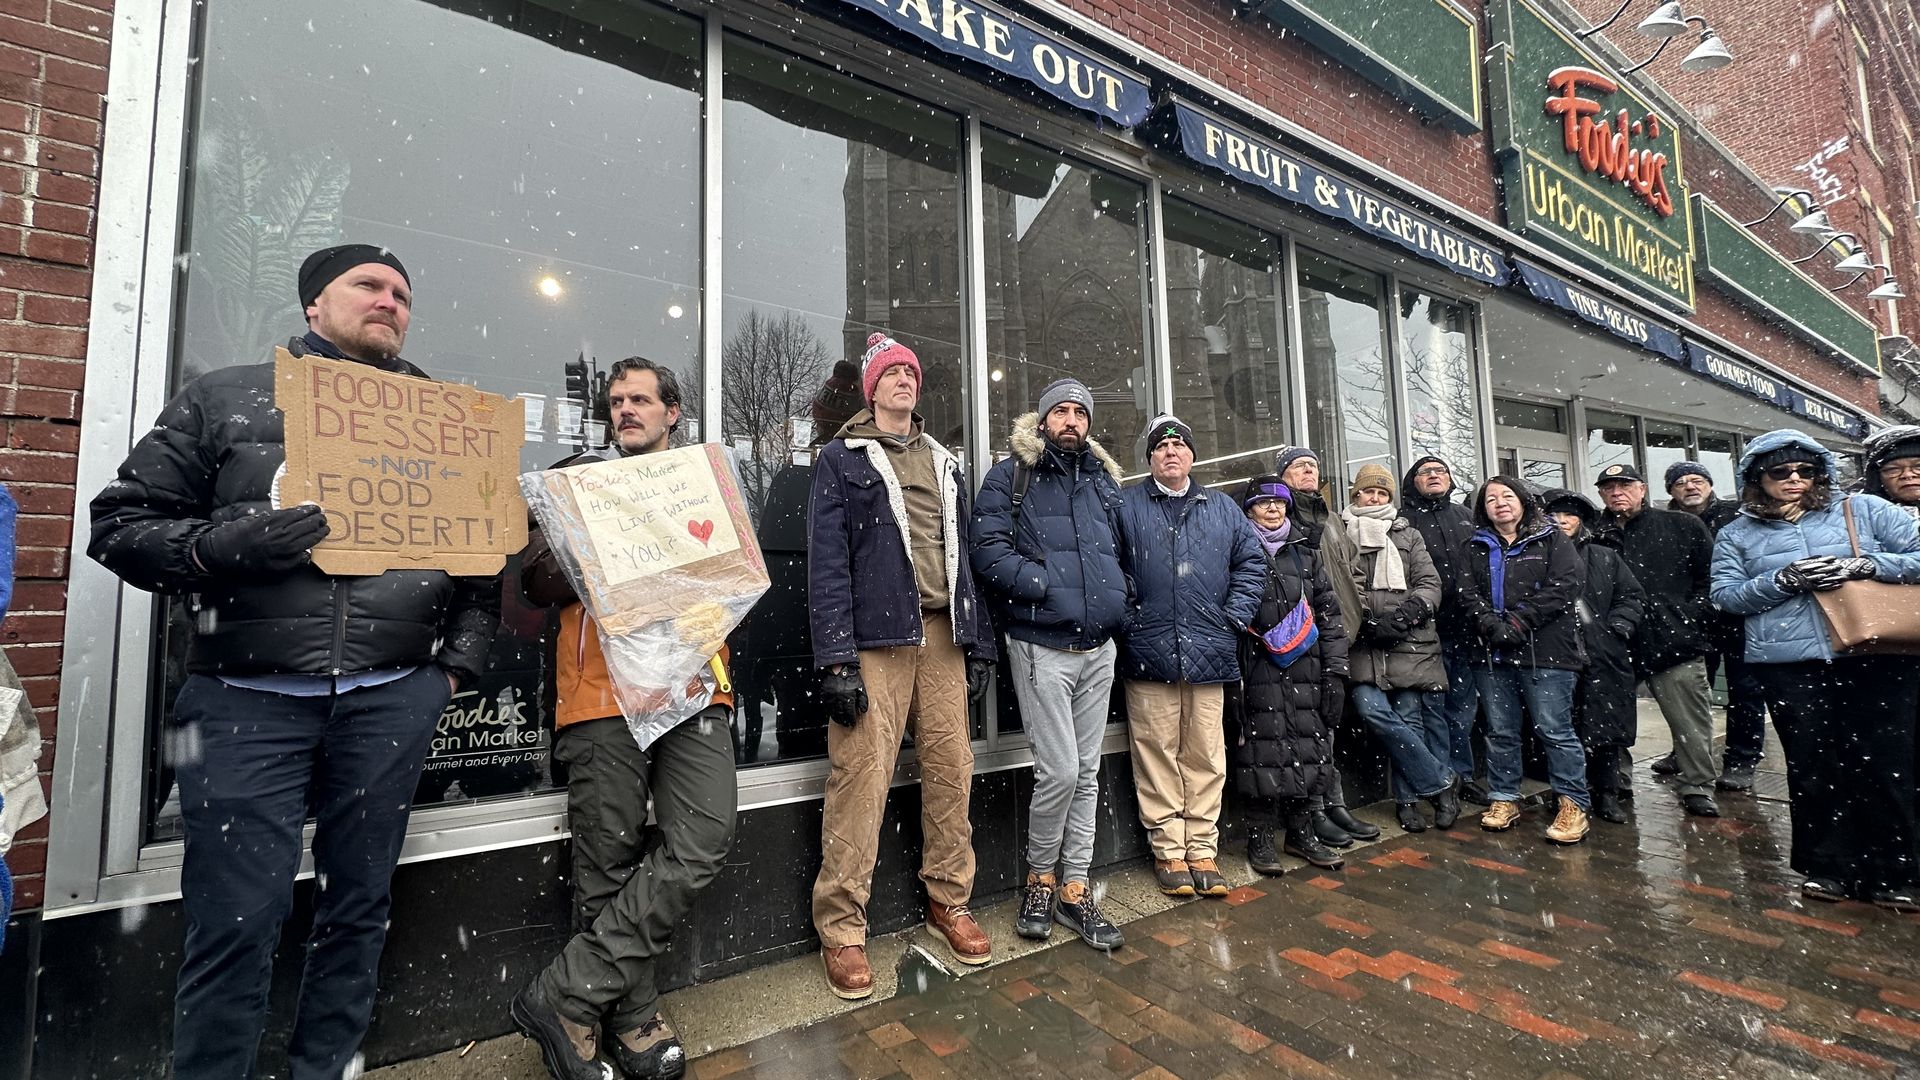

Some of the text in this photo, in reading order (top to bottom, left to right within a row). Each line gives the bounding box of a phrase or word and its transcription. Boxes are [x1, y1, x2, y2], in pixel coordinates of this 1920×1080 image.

[876, 0, 1123, 112] AKE OUT
[1545, 66, 1674, 216] Foodie's
[1203, 121, 1497, 278] FRUIT & VEGETABLES
[1525, 162, 1685, 294] Urban Market
[1566, 287, 1604, 320] FINE
[312, 365, 466, 424] FOODIE'S
[1705, 354, 1776, 398] GOURMET FOOD
[314, 403, 500, 457] DESSERT
[381, 454, 436, 480] NOT
[636, 463, 680, 481] Market
[705, 445, 742, 516] THANK
[317, 472, 433, 508] FOOD
[590, 482, 688, 514] HOW WILL WE
[322, 509, 495, 547] DESERT!
[617, 495, 710, 532] LIVE WITHOUT
[739, 521, 764, 569] YOU
[435, 688, 527, 734] oodie's
[468, 727, 544, 748] Market
[422, 751, 547, 771] ourmet and Every Day
